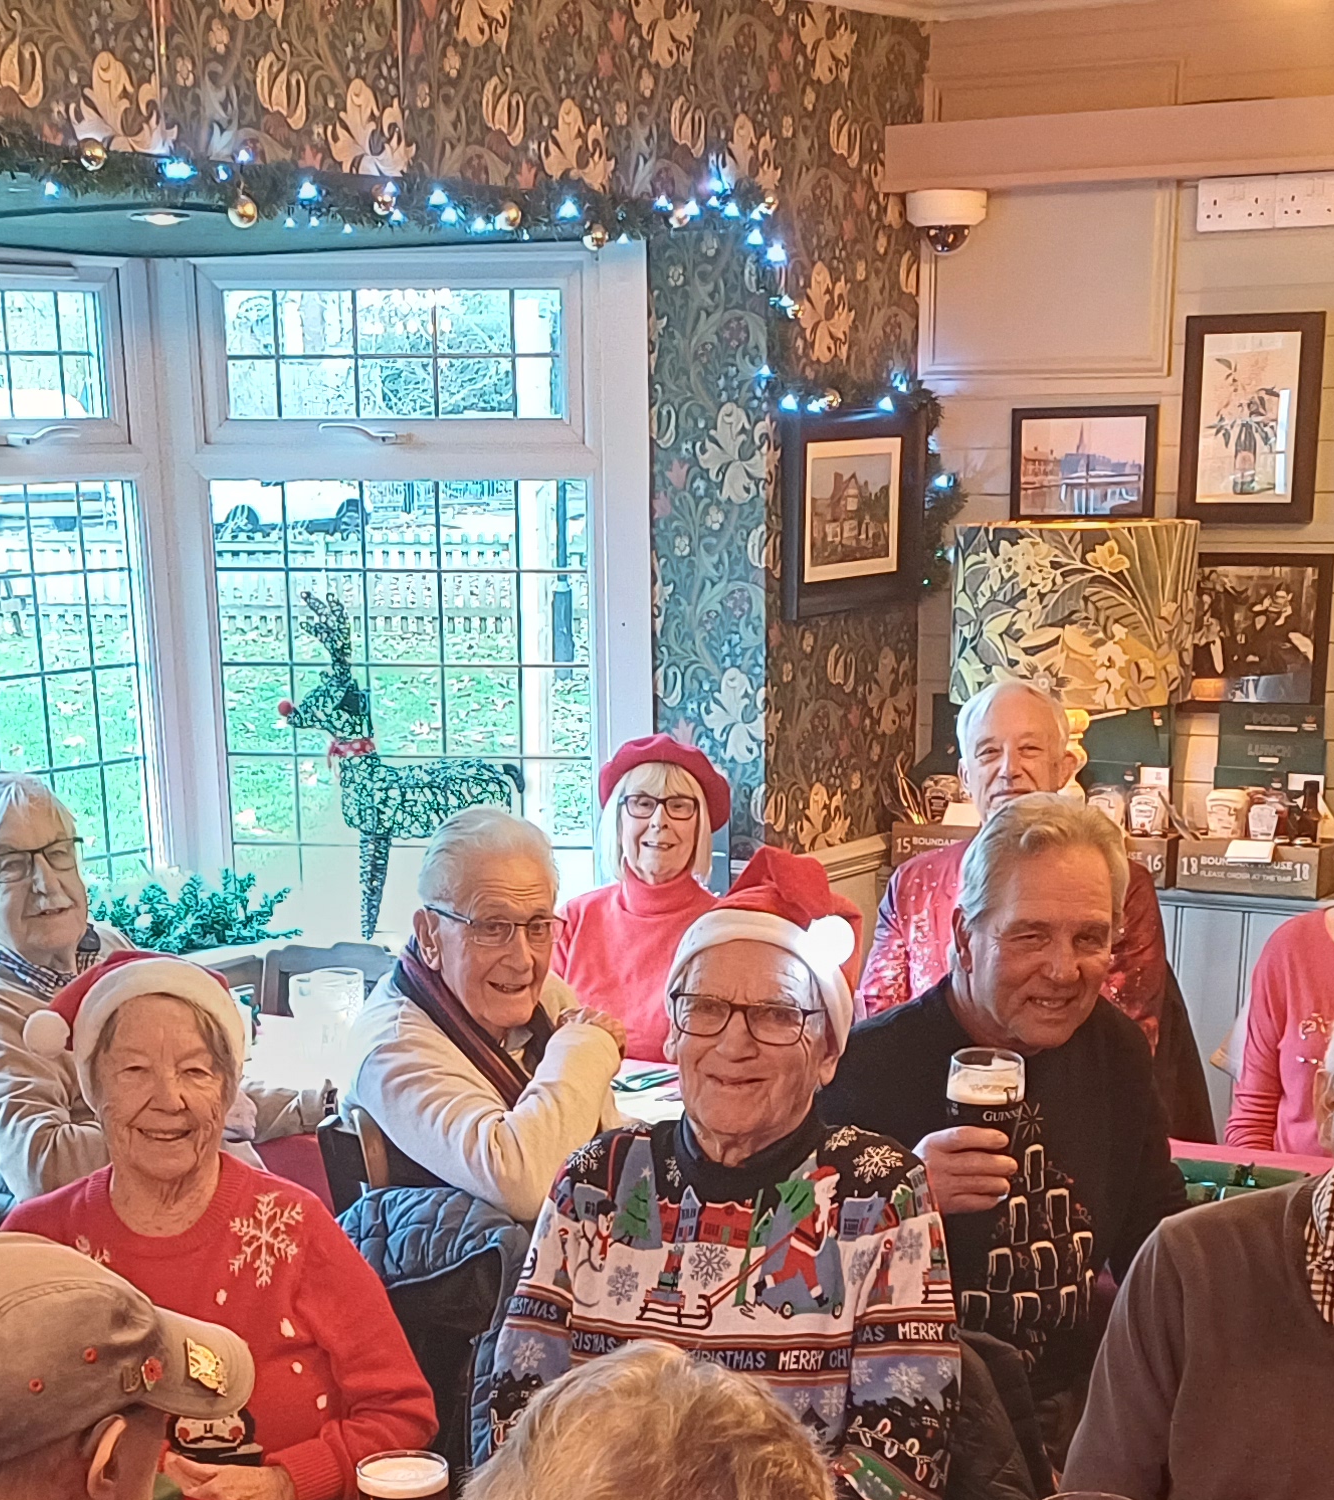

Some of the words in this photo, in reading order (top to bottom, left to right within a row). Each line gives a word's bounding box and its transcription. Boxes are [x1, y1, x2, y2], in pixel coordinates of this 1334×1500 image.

[896, 837, 911, 853] 15
[1146, 854, 1163, 874] 16
[1181, 857, 1199, 876] 18
[1293, 863, 1310, 881] 18
[897, 1321, 945, 1341] MERRY
[778, 1349, 825, 1371] MERRY
